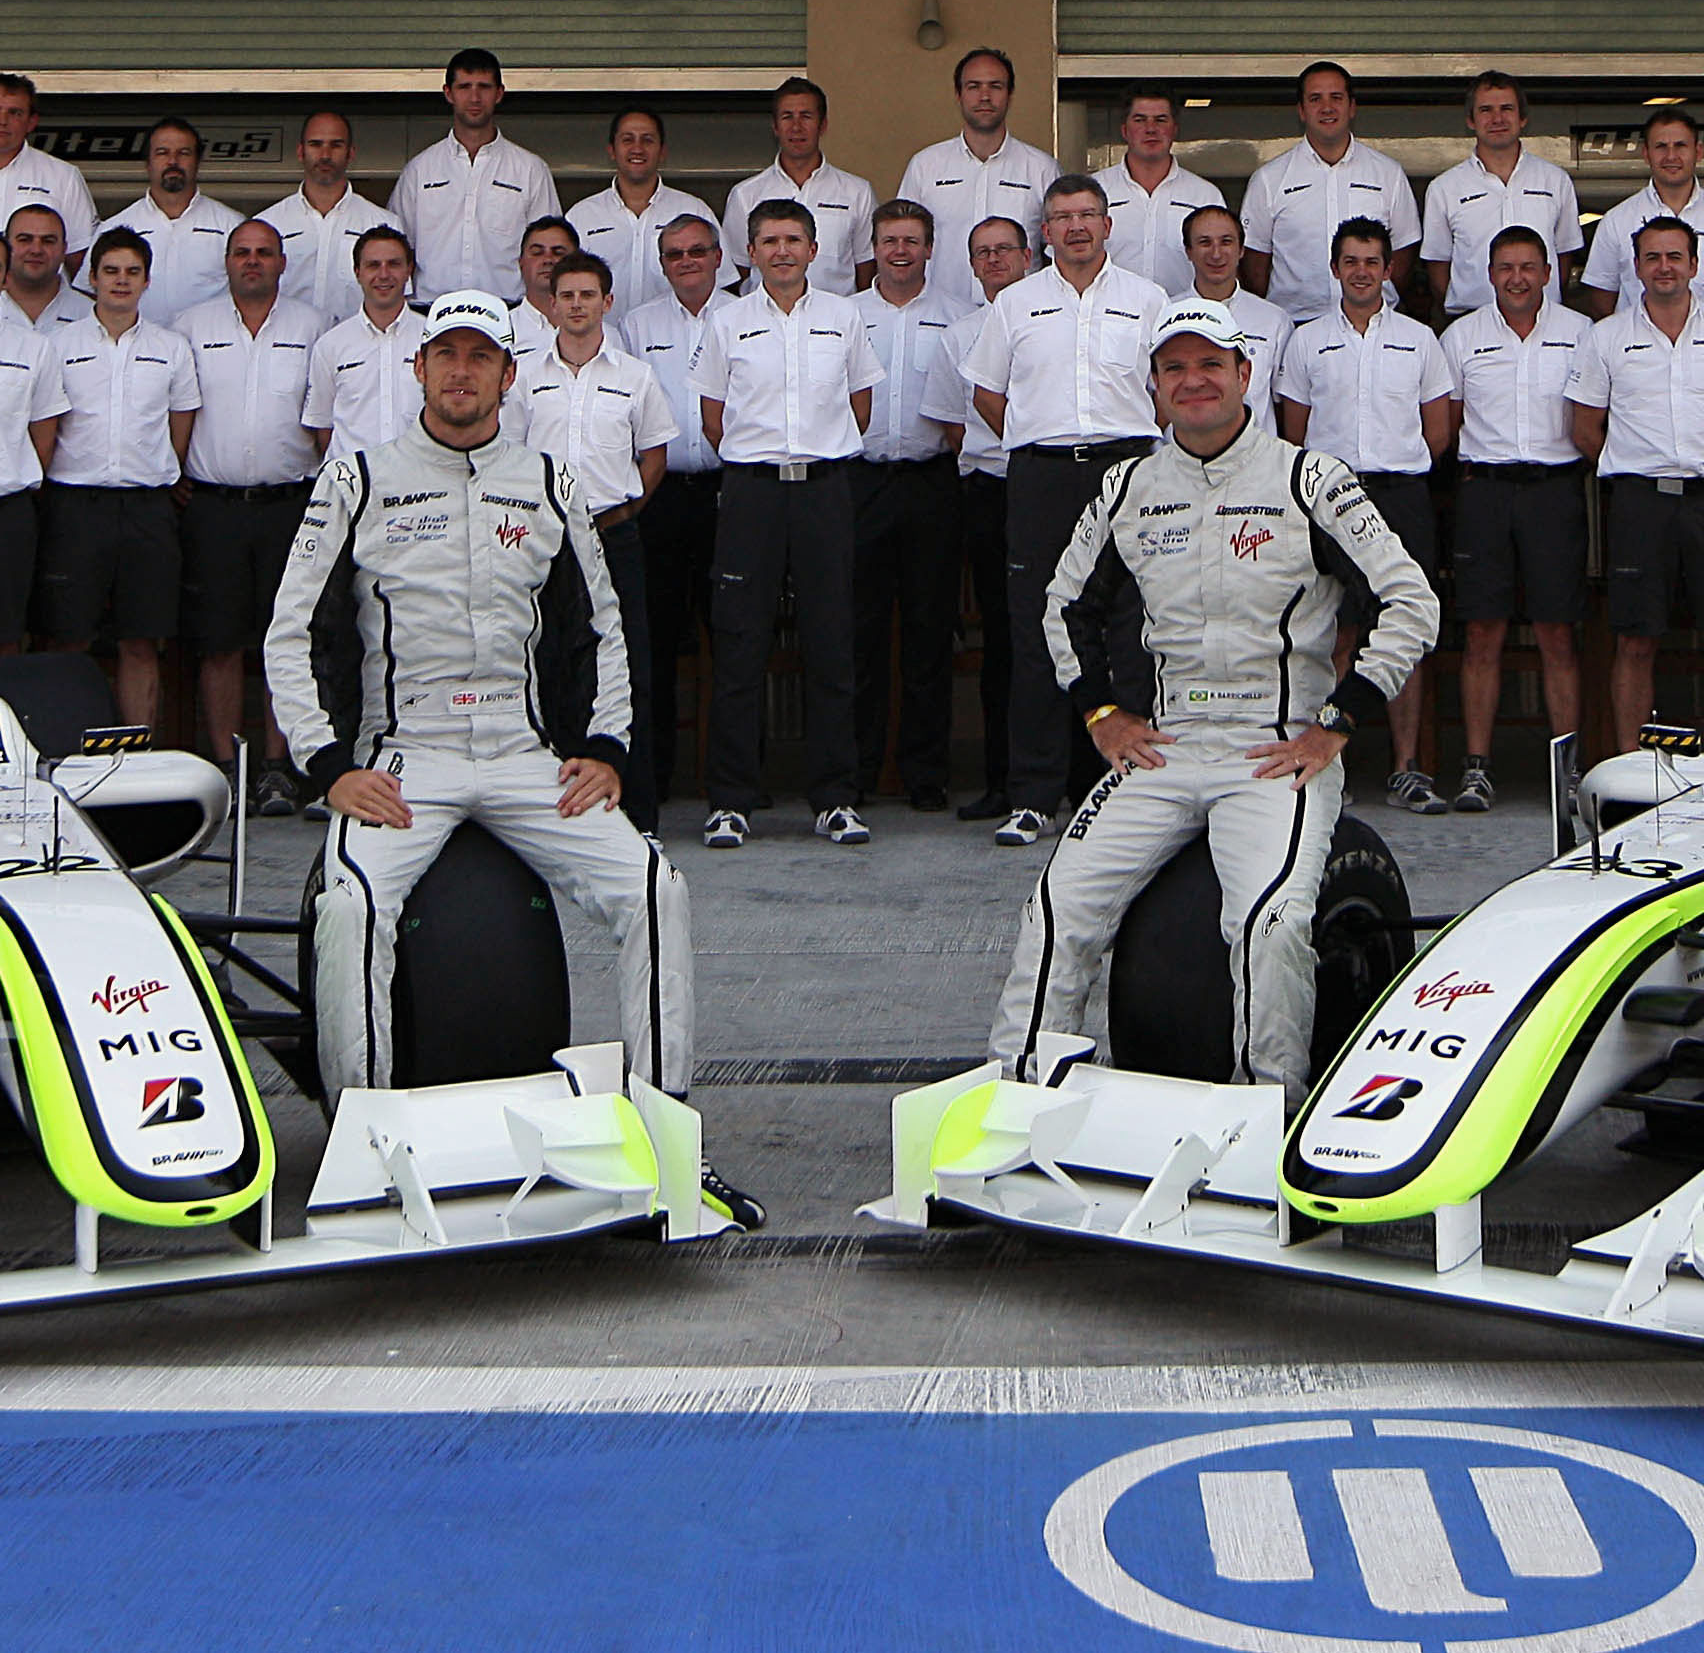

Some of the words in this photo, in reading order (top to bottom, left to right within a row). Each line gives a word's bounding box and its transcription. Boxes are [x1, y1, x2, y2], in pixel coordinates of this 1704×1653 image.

[1215, 505, 1286, 518] BRIDGESTONE
[1230, 519, 1275, 561] Virgin
[91, 975, 170, 1015] Virgin
[1414, 971, 1495, 1012] Virgin
[99, 1030, 203, 1061] MIG
[1365, 1028, 1466, 1059] MIG
